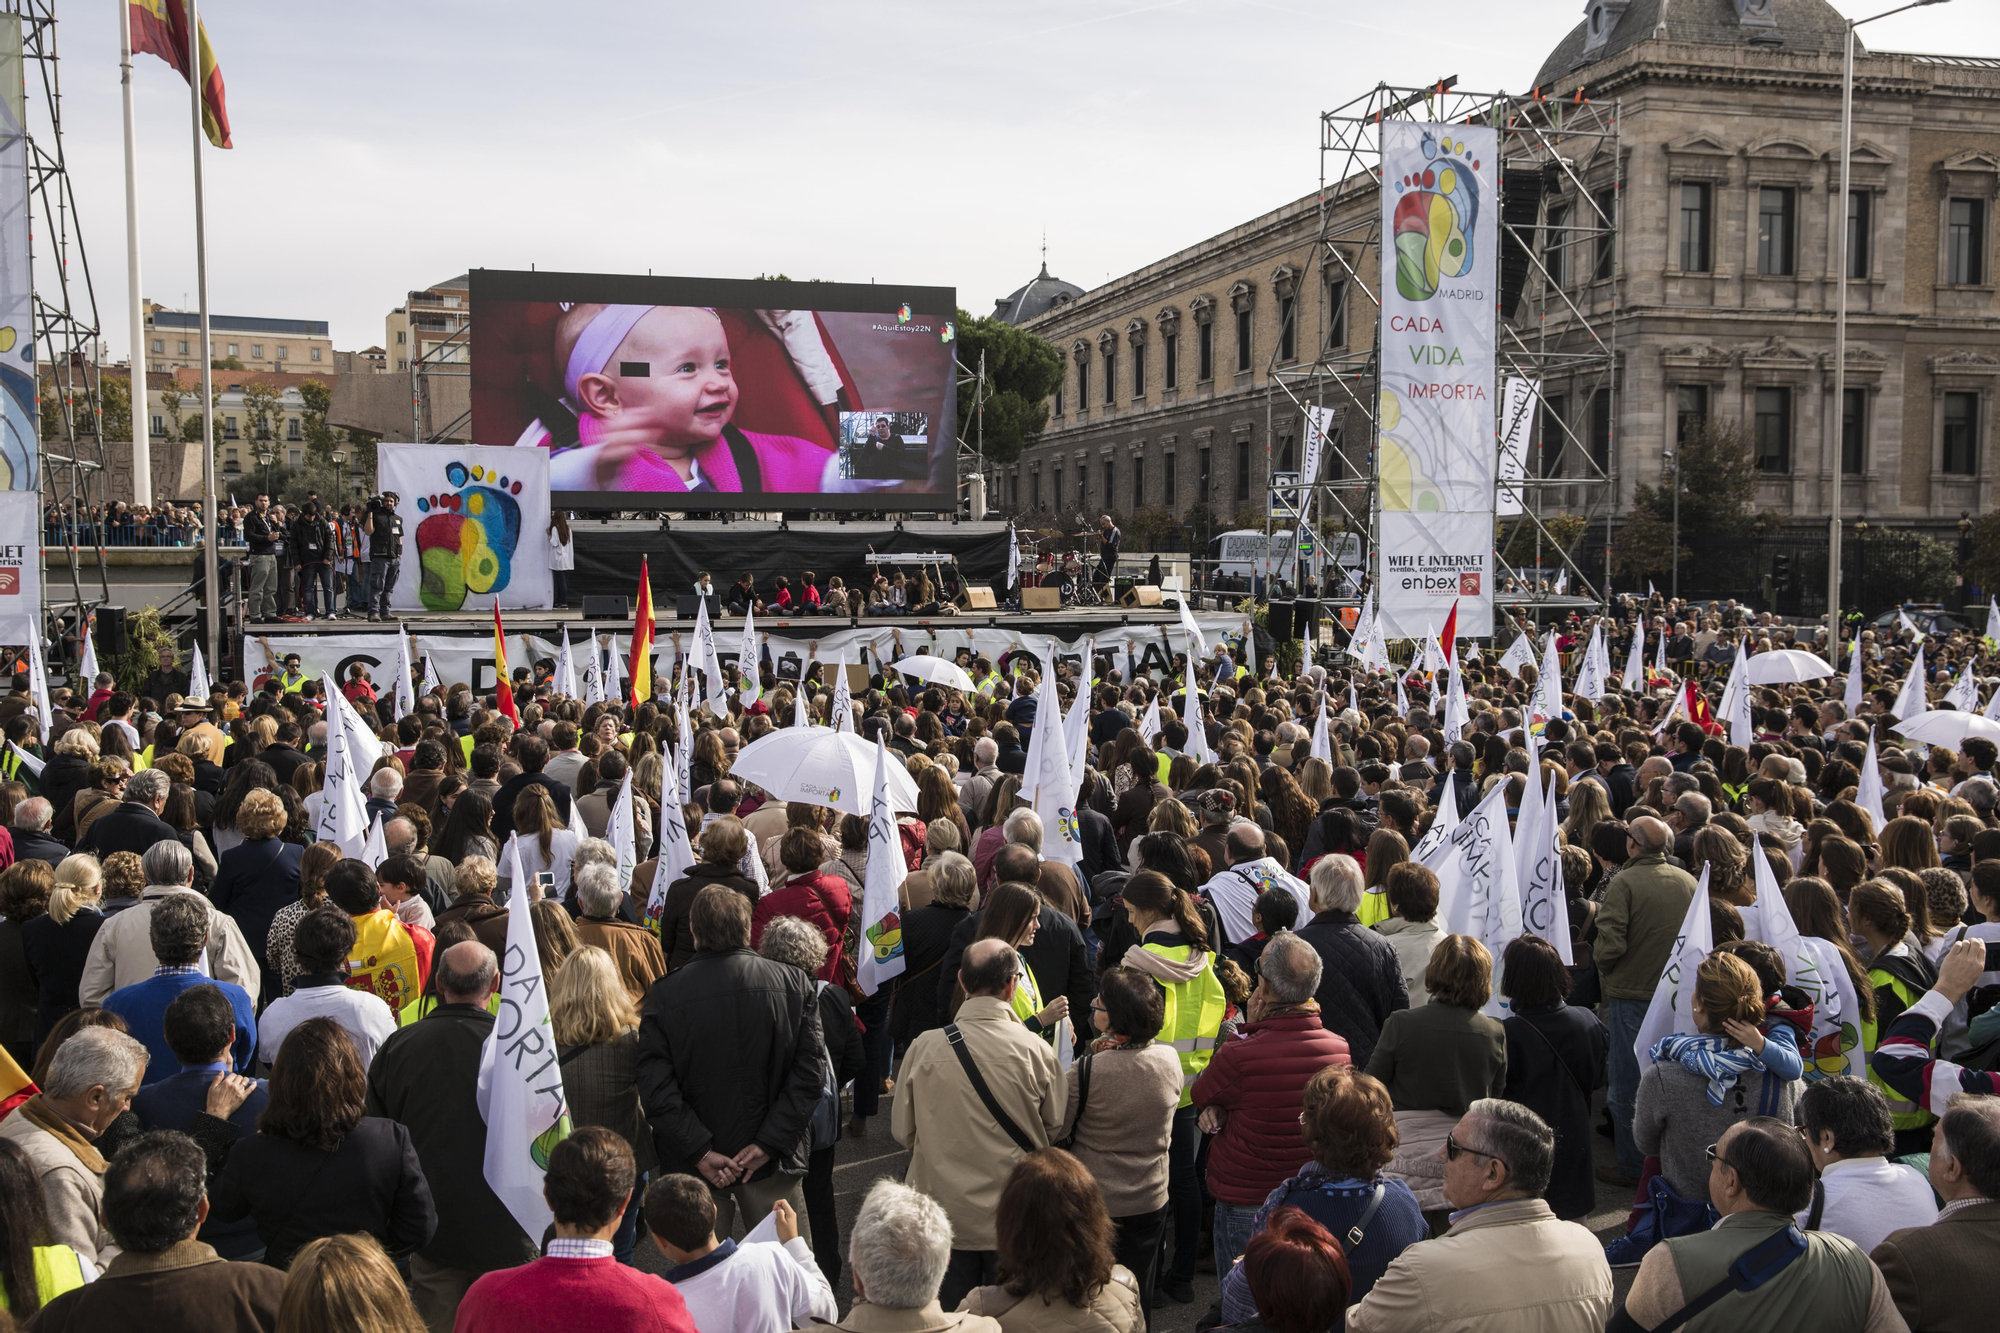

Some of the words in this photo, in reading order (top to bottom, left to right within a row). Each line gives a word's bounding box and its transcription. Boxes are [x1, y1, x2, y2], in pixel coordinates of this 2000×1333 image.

[1439, 289, 1484, 301] MADRID
[872, 324, 931, 333] #AquiEstoy22N
[1391, 315, 1444, 334] CADA
[1408, 344, 1465, 366] VIDA
[1408, 382, 1487, 401] IMPORTA
[1388, 555, 1414, 567] WIFI
[1418, 555, 1426, 567] E
[1429, 554, 1484, 566] INTERNET
[1389, 566, 1418, 574] eventos,
[1419, 566, 1456, 574] congresos
[1463, 565, 1483, 573] ferias
[1401, 574, 1457, 590] enbex
[800, 787, 830, 797] IMPORTA
